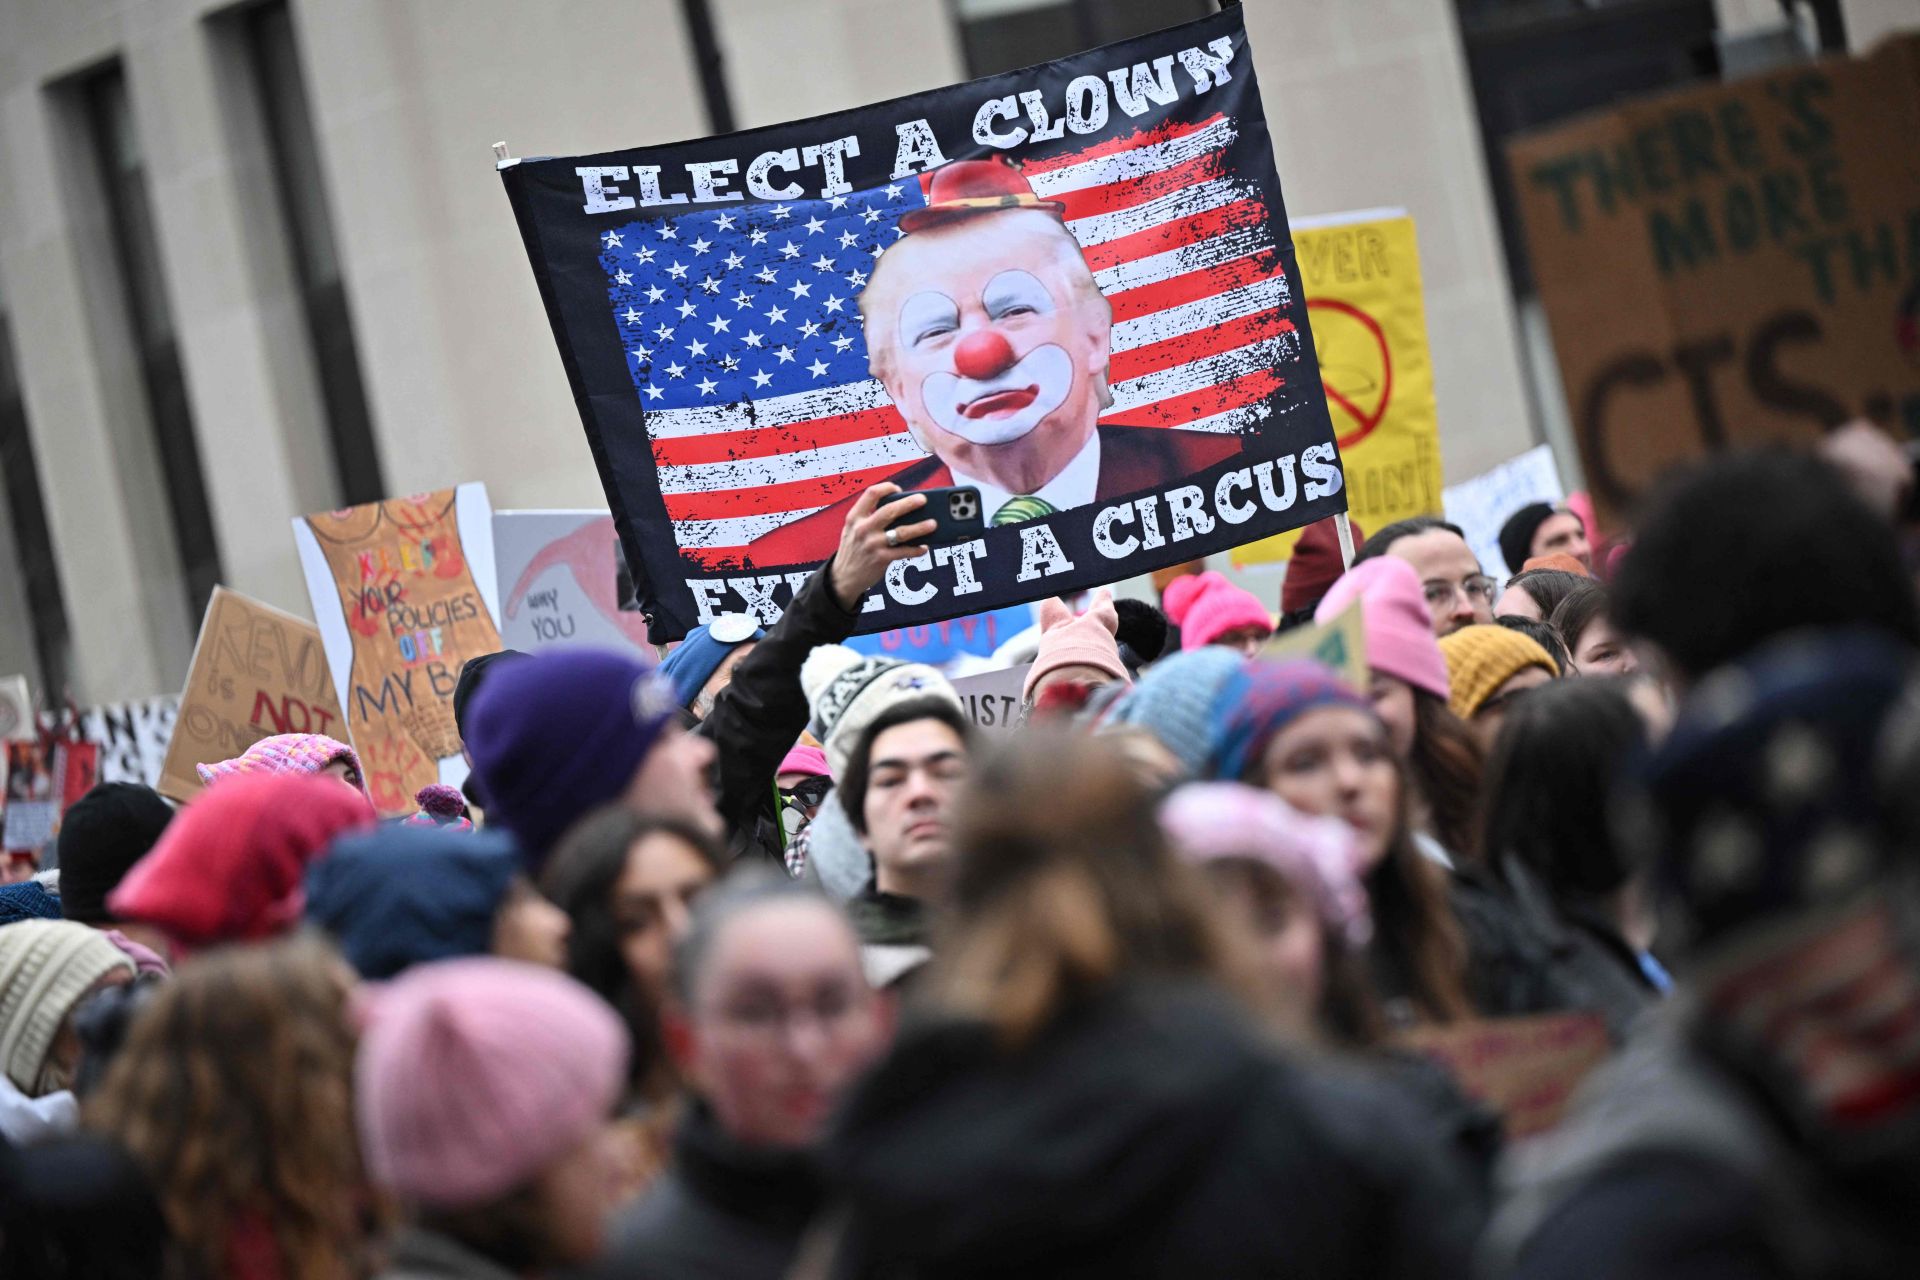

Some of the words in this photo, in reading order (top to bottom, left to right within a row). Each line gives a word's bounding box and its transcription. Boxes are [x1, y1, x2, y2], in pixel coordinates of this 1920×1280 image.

[575, 135, 861, 215] ELECT
[889, 118, 955, 180] A
[972, 35, 1235, 149] CLOWN
[1650, 157, 1849, 280] MORE
[1298, 227, 1391, 286] VER
[685, 538, 988, 626] EXCT
[1016, 523, 1075, 583] A
[1092, 441, 1343, 560] CIRCUS
[347, 580, 406, 619] YOUR
[387, 592, 478, 639] POLICIES
[207, 593, 335, 702] REVO
[531, 614, 576, 642] YOU
[250, 690, 335, 735] NOT
[356, 669, 414, 722] MY
